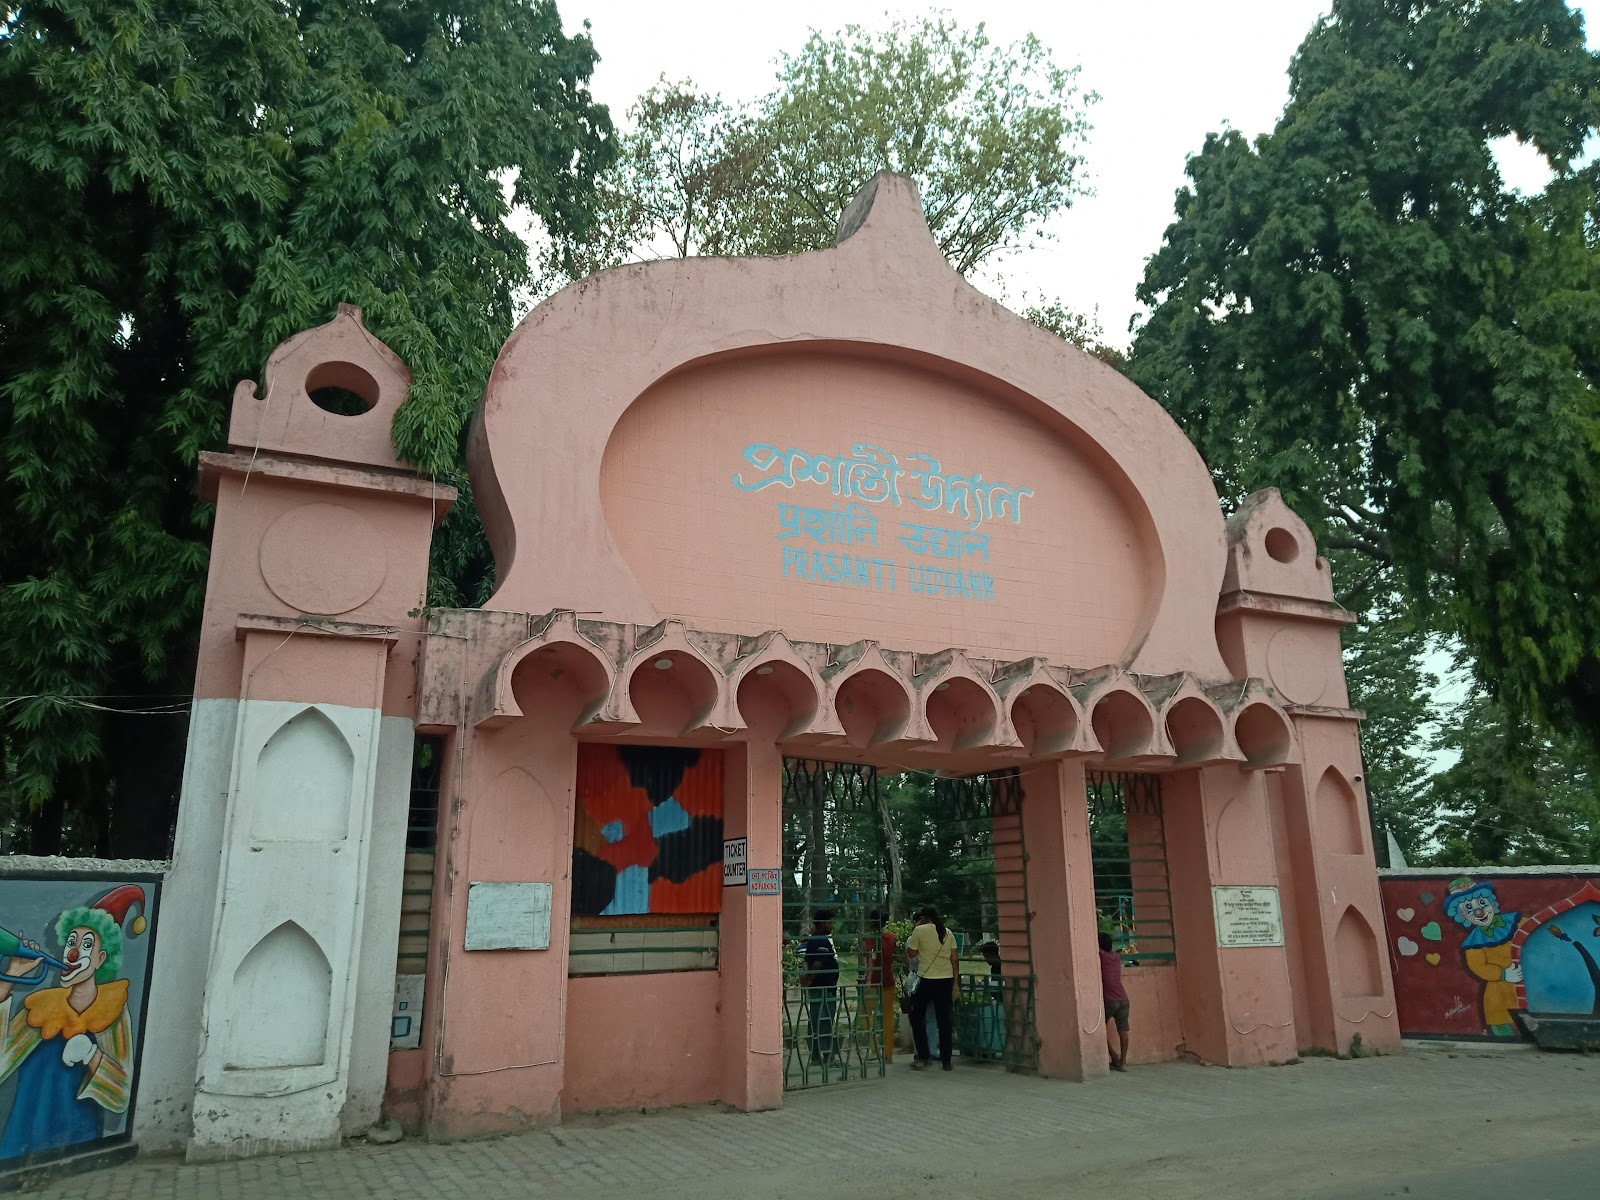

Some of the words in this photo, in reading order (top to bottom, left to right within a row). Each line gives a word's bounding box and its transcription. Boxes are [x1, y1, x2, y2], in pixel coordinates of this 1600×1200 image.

[906, 453, 1035, 530] উদ্যান
[776, 502, 880, 548] प्रशांति
[899, 522, 992, 564] उद्यान
[783, 545, 896, 591] PRASANTI
[724, 862, 746, 877] COUNTER
[725, 842, 746, 858] TICKET
